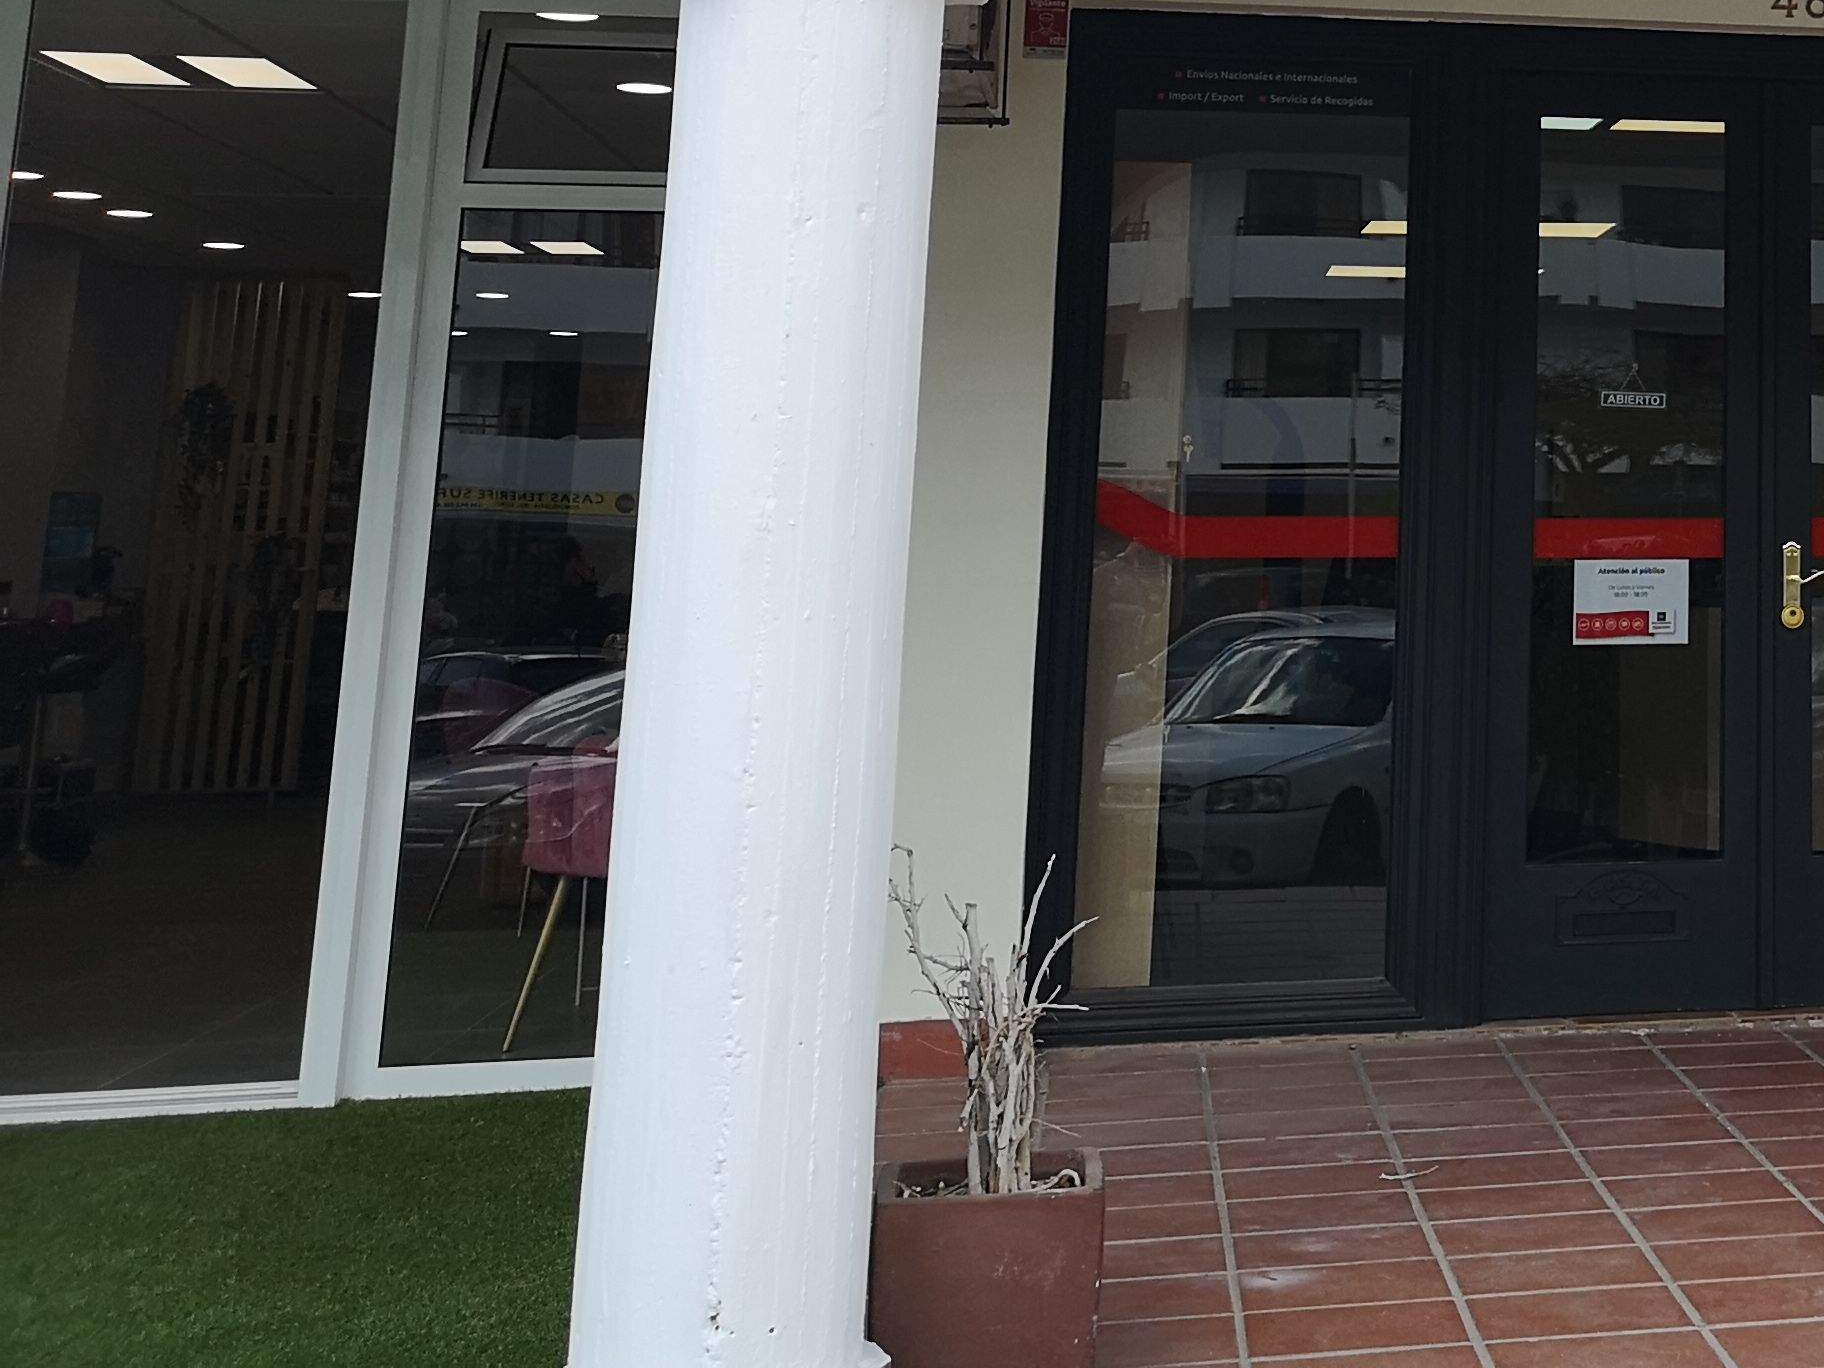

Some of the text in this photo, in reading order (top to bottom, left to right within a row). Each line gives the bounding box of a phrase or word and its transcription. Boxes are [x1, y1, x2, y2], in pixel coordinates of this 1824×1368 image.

[1168, 92, 1203, 103] Import
[1211, 92, 1245, 103] Export
[1310, 95, 1322, 104] de
[1607, 394, 1660, 406] ABIERTO
